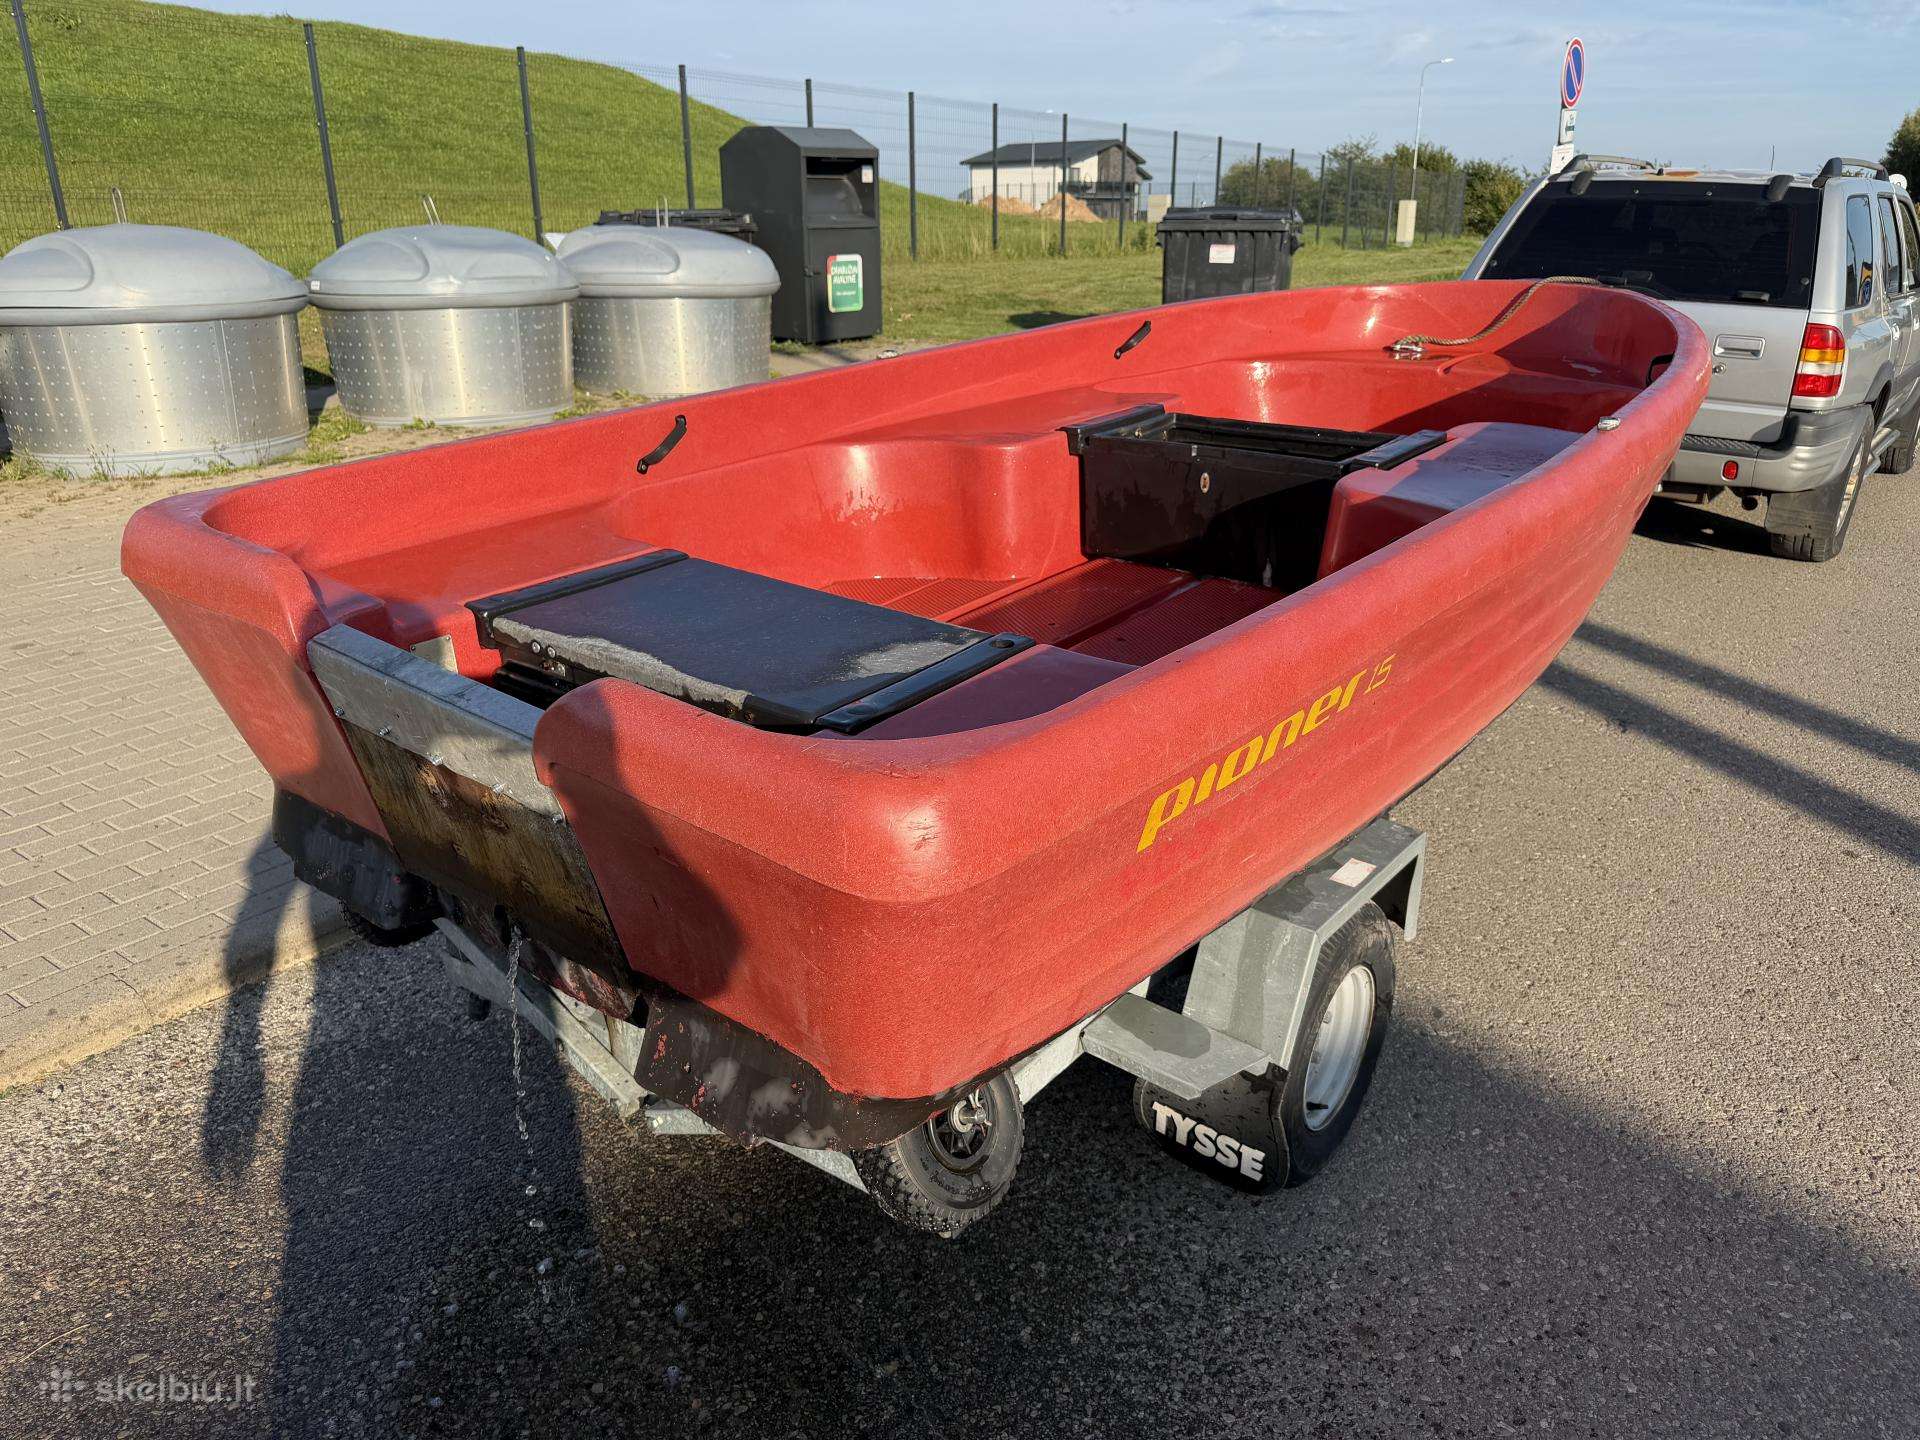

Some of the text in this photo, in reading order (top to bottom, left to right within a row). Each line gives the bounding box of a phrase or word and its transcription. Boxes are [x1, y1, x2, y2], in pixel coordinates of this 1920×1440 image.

[1136, 653, 1396, 853] pioner 15
[1152, 1101, 1266, 1182] TYSSE
